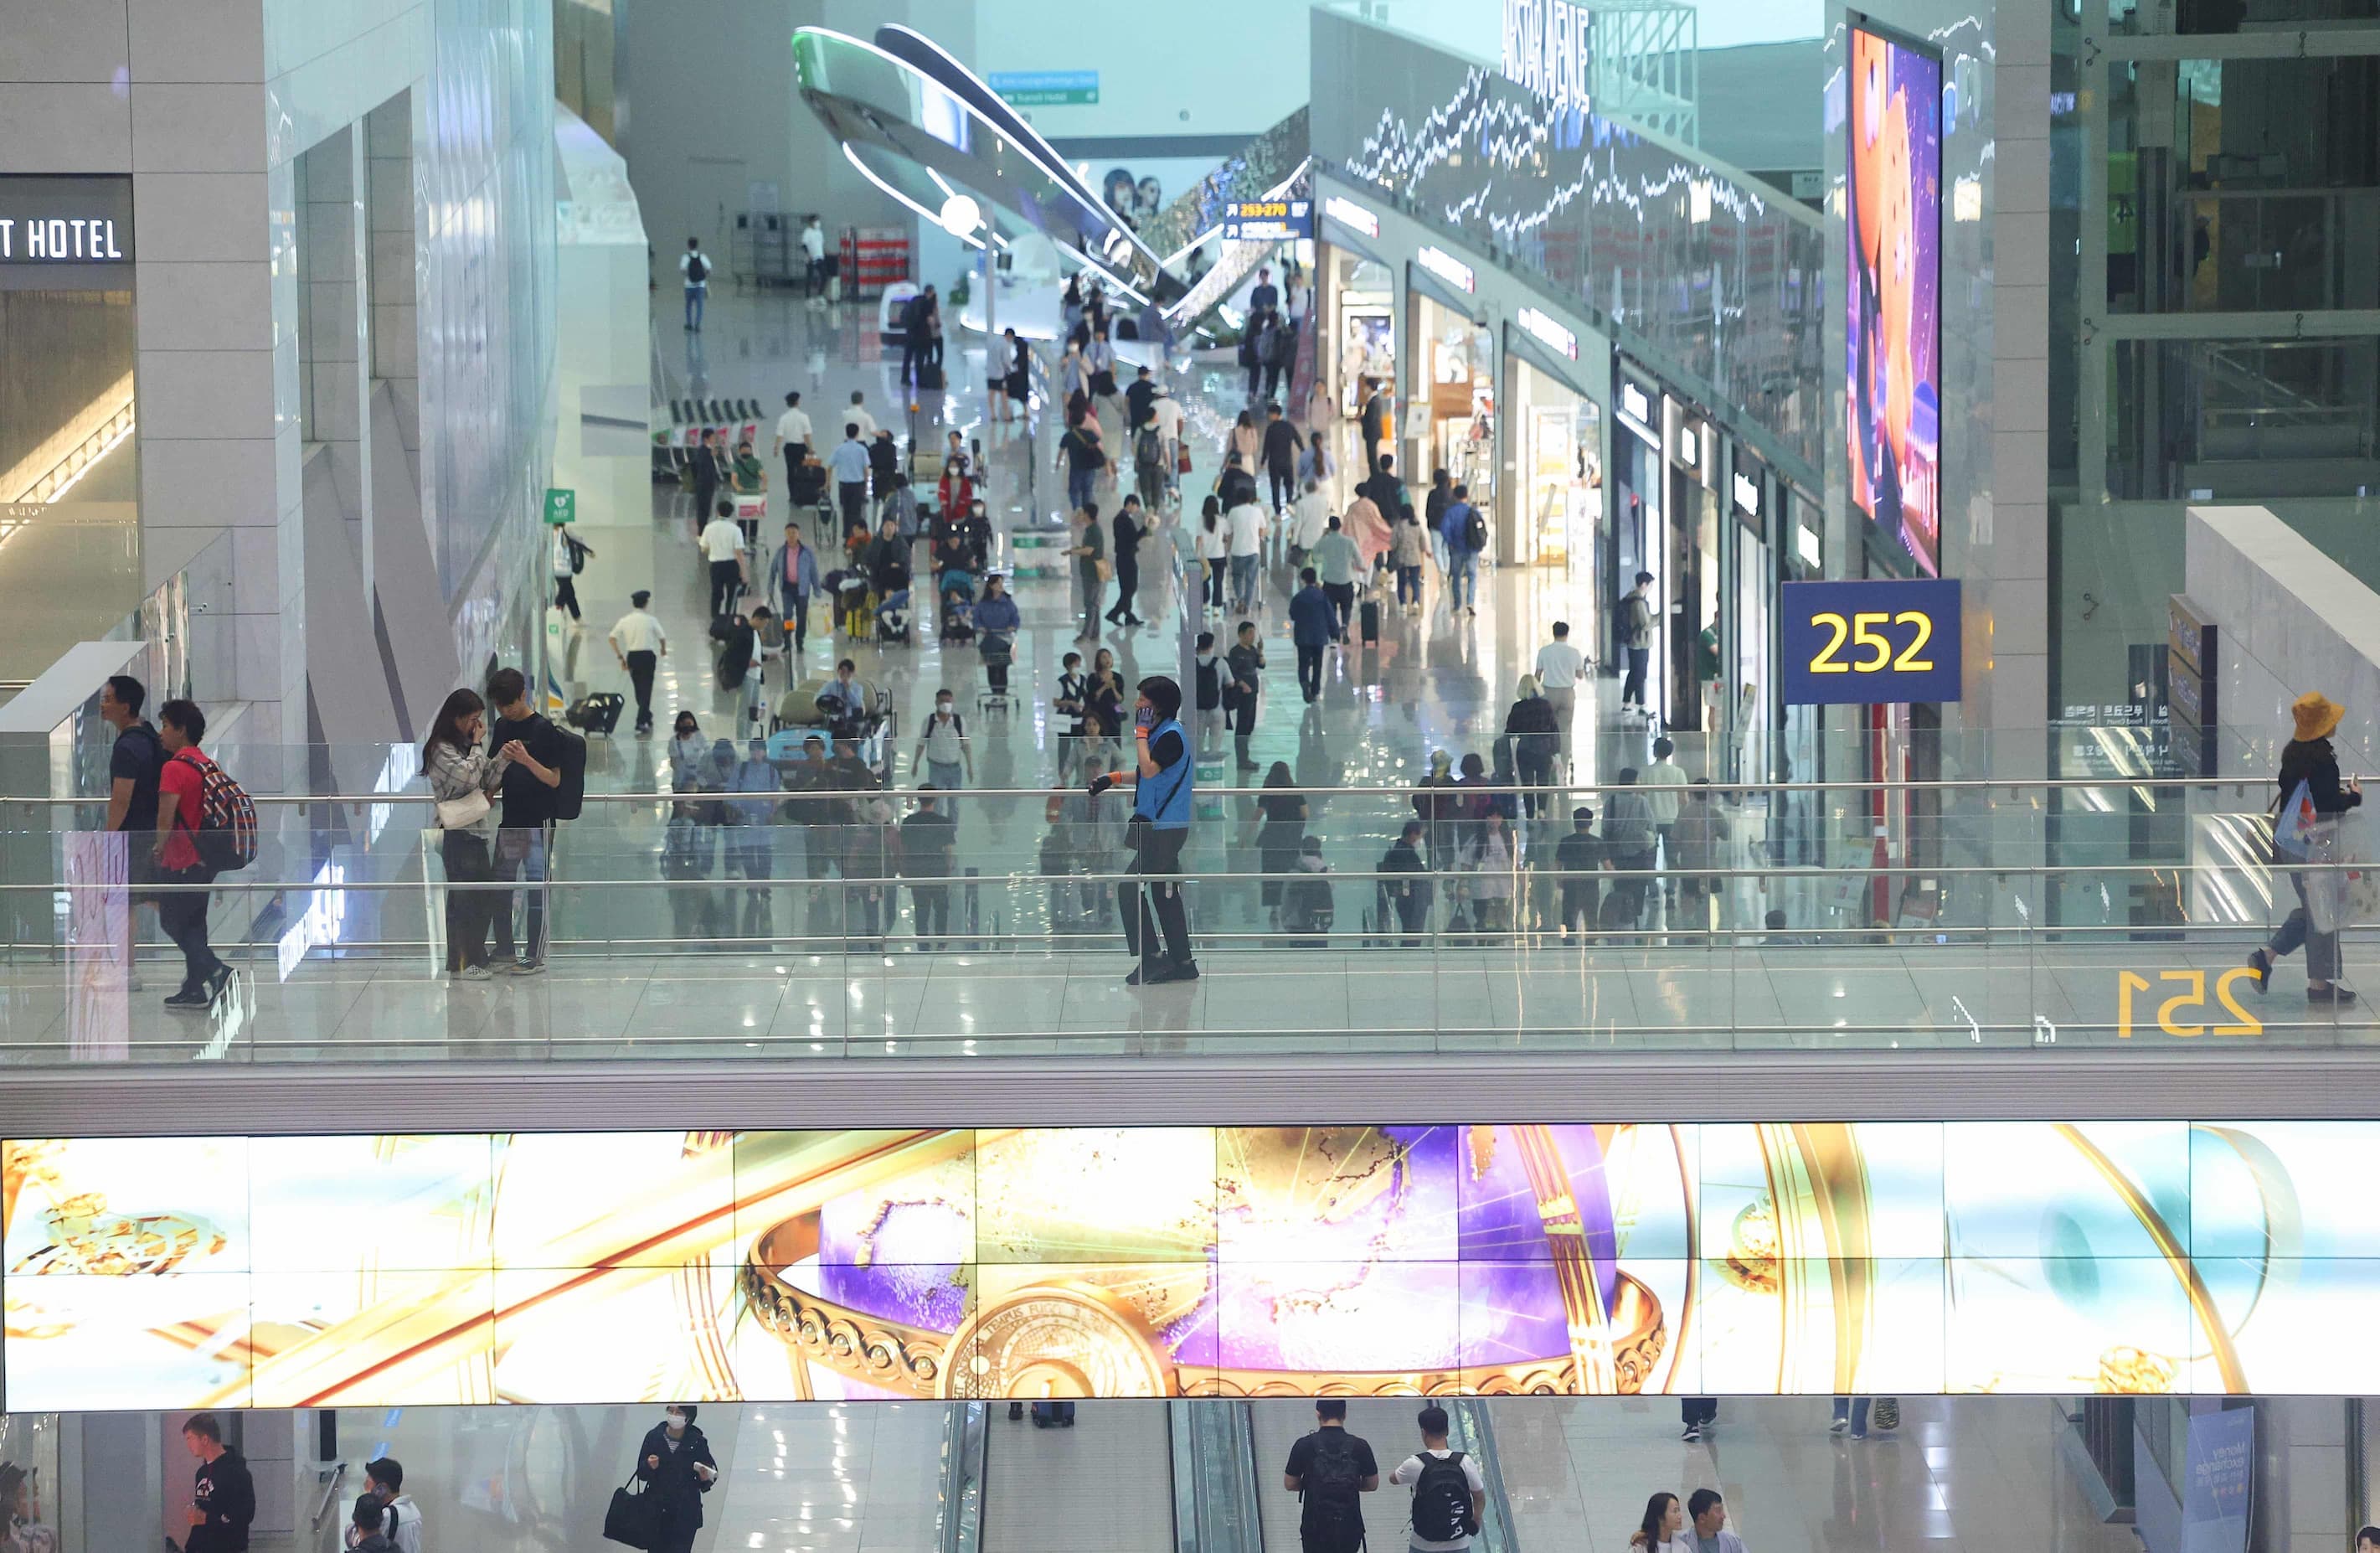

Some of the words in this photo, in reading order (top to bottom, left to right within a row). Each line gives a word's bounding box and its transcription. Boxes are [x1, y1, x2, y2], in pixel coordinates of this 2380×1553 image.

[1240, 203, 1287, 217] 253-270
[28, 219, 122, 258] HOTEL
[1809, 611, 1934, 673] 252
[985, 1307, 1023, 1334] TEMPUS
